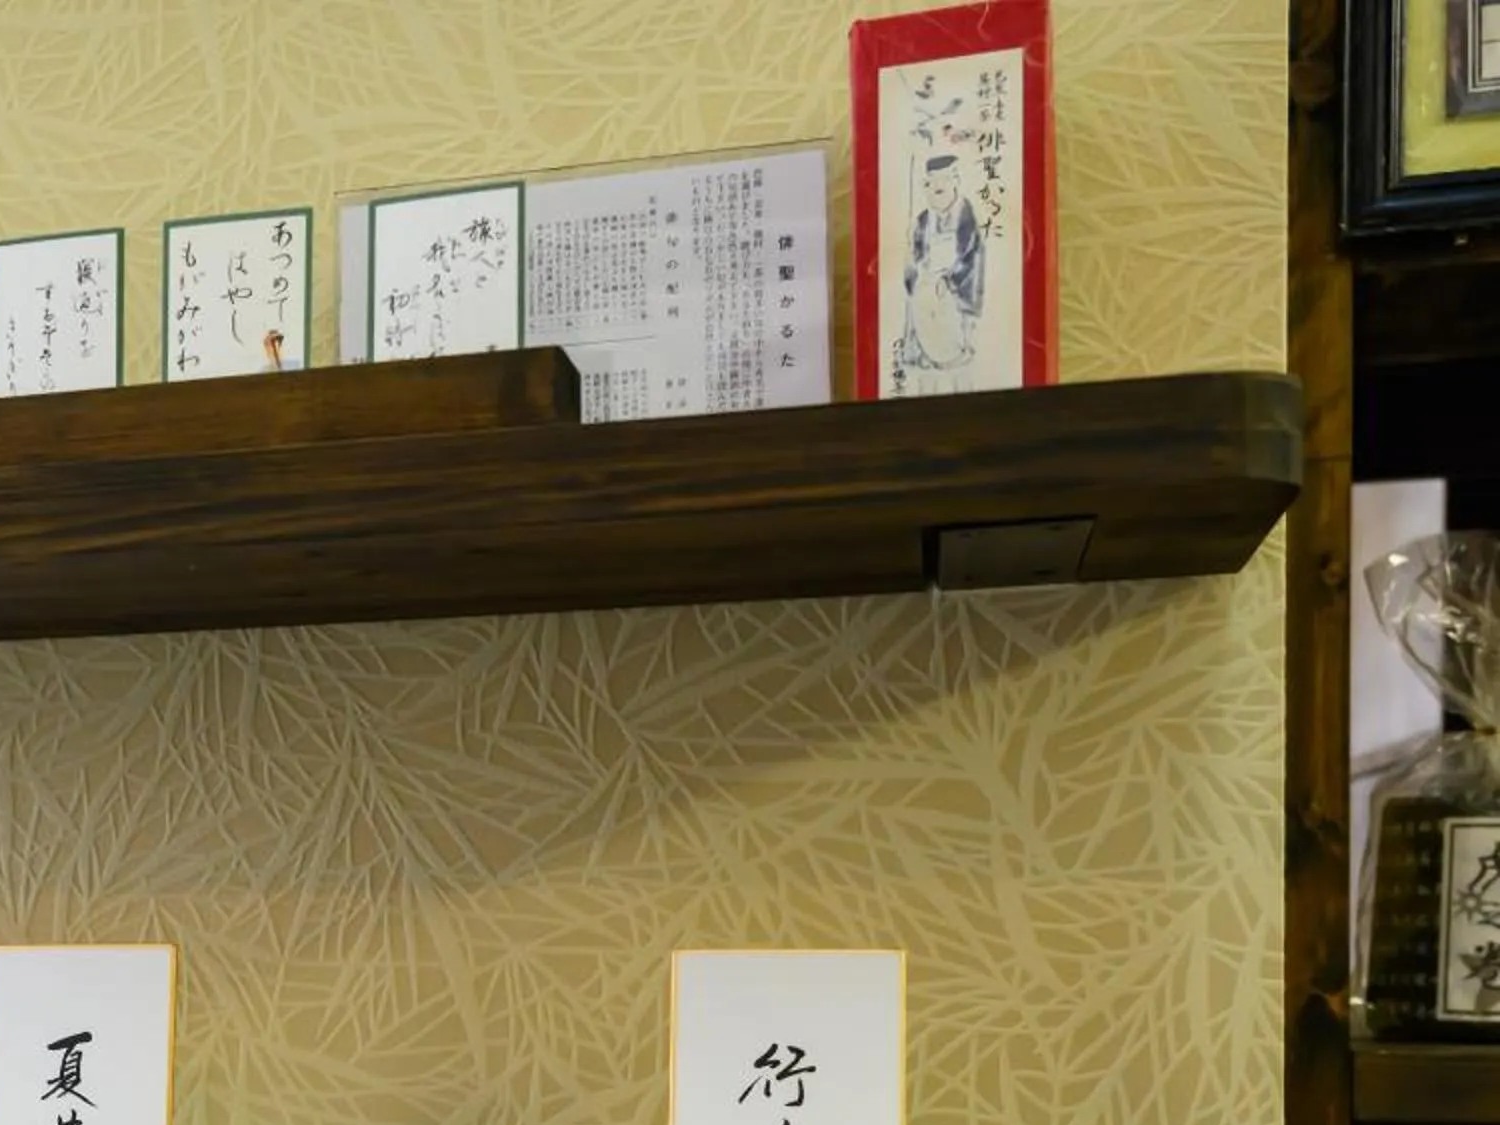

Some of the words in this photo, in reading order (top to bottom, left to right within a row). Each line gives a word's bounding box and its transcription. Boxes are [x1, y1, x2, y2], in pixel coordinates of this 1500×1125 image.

[176, 241, 206, 374] もがみがわ
[220, 251, 253, 347] はやし
[268, 219, 293, 322] あつめて
[777, 234, 795, 369] 俳聖かるた
